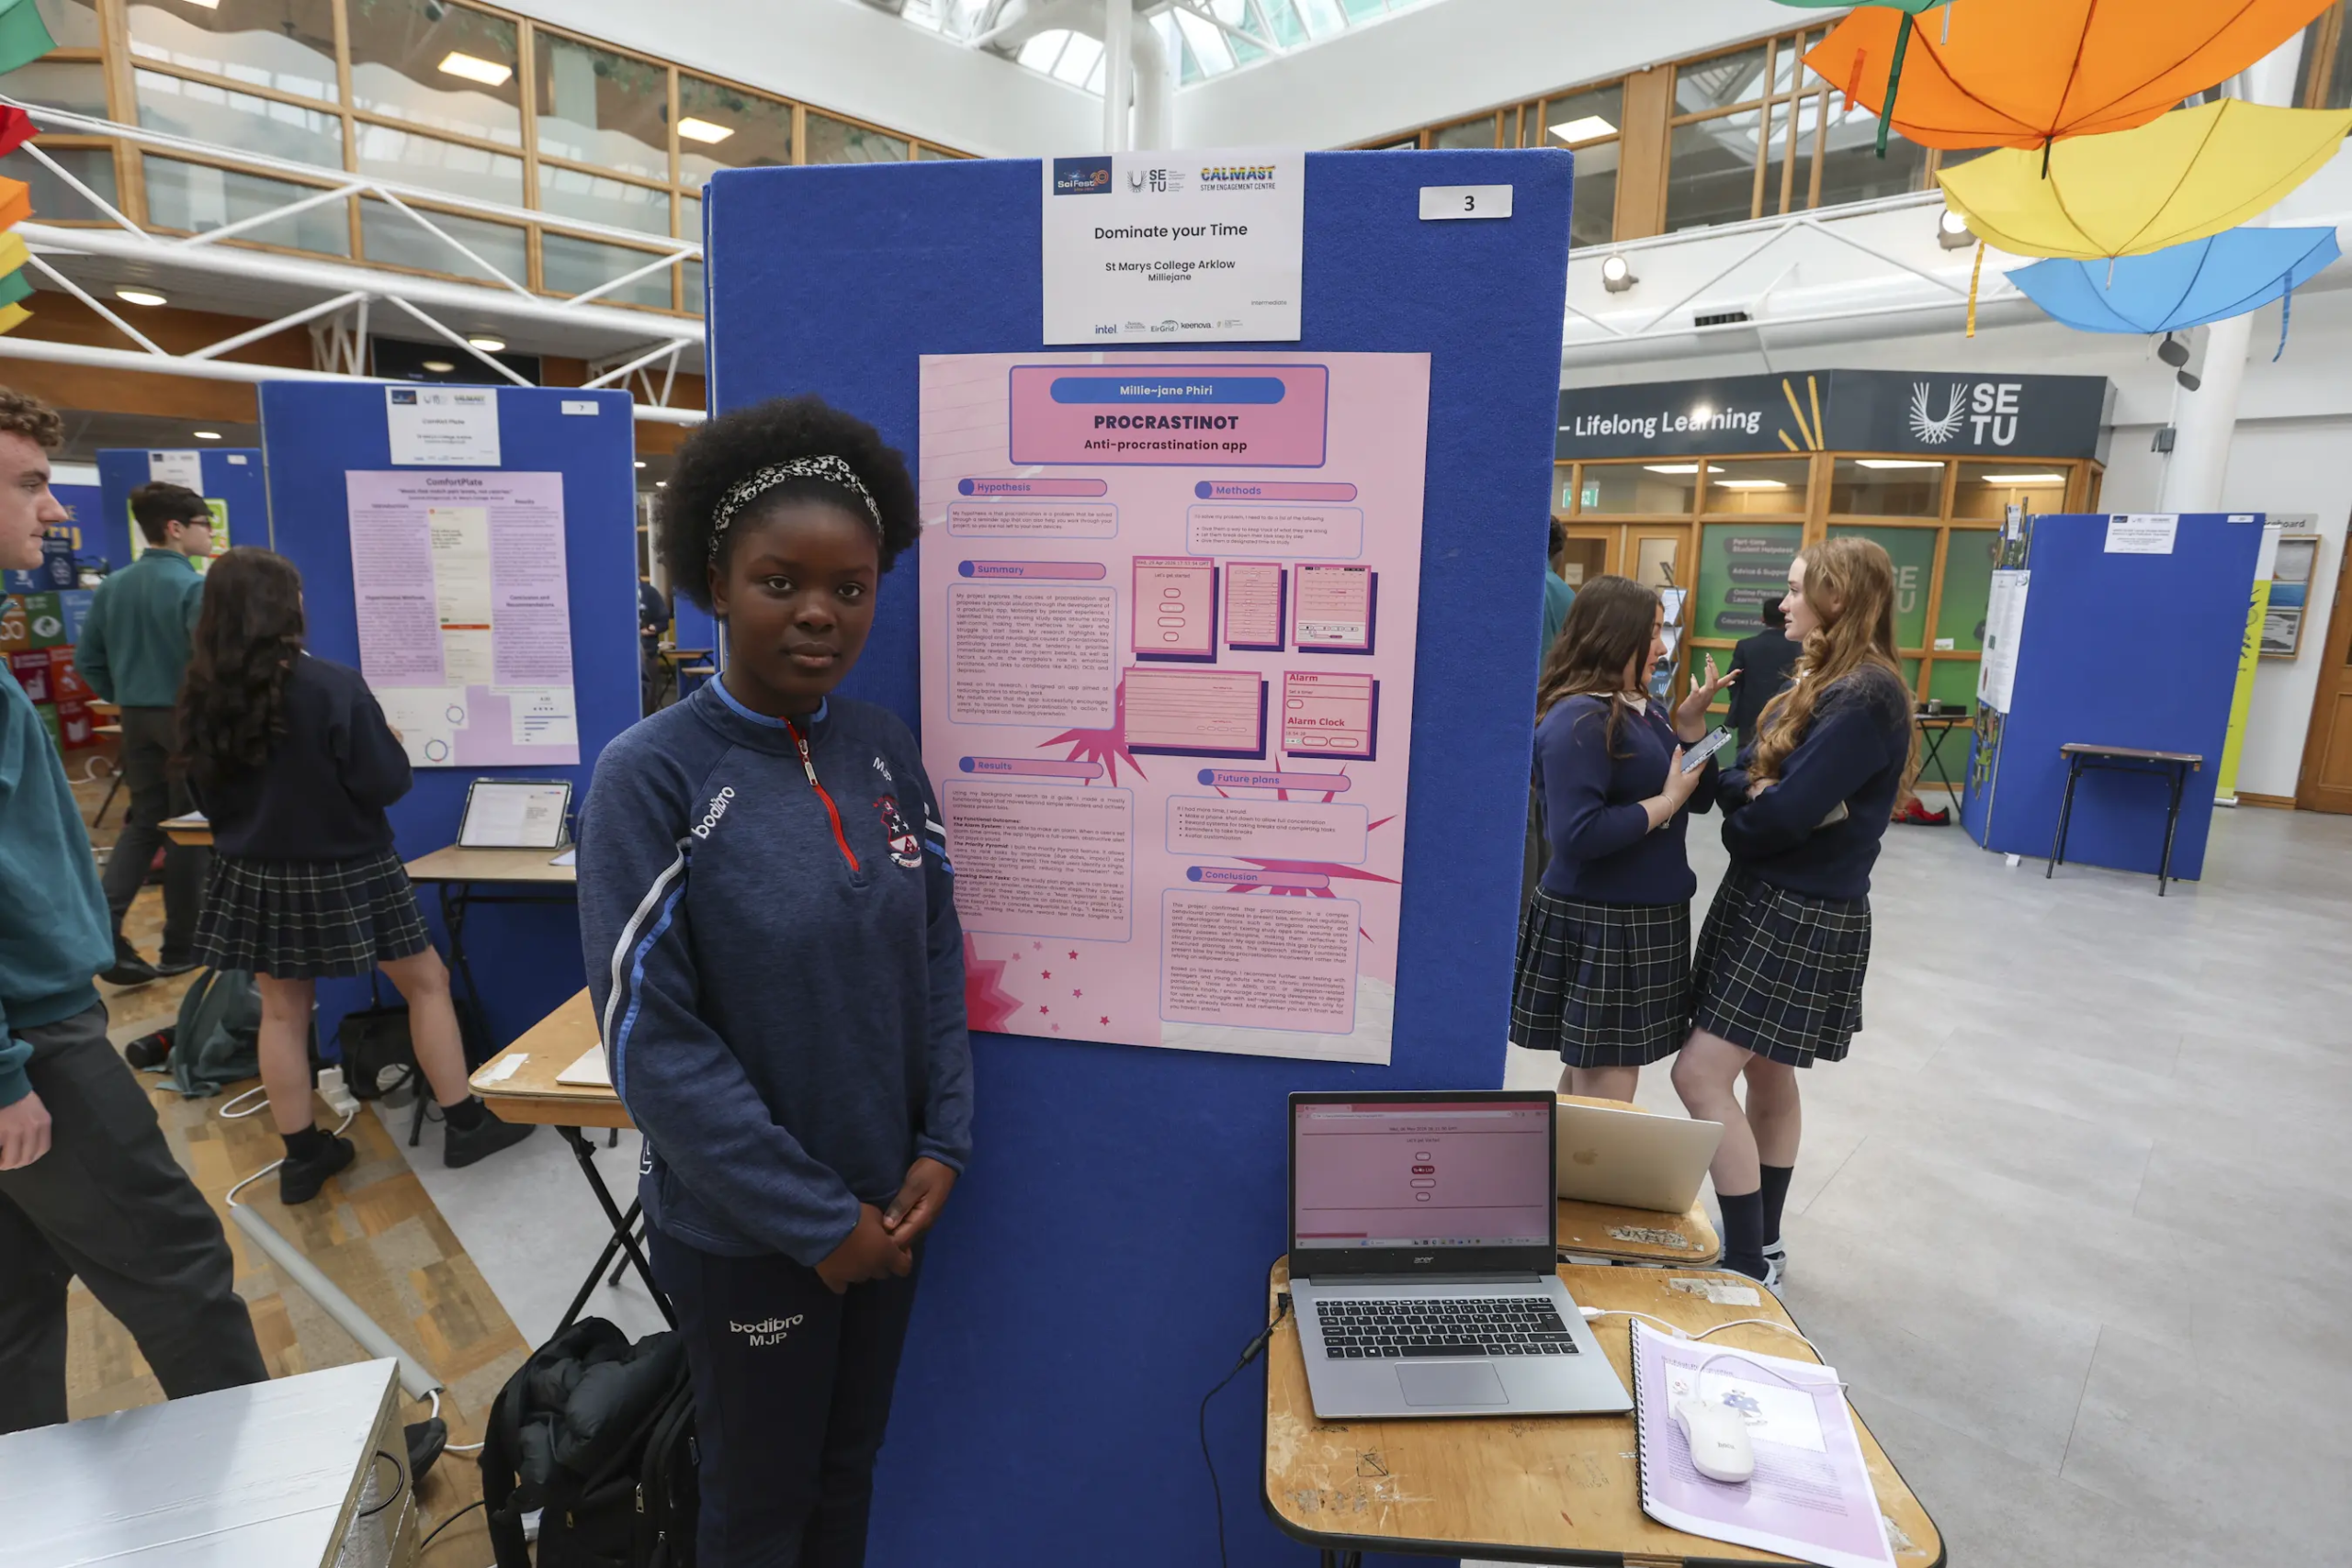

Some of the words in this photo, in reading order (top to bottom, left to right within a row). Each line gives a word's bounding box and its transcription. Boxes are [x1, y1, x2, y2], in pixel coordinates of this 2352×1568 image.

[1057, 179, 1095, 188] SciFest
[1090, 169, 1109, 186] 20
[1149, 169, 1167, 181] SE
[1200, 164, 1276, 182] CALMAST
[1150, 181, 1167, 193] TU
[1216, 183, 1253, 191] ENGAGEMENT
[1254, 182, 1276, 190] CENTRE
[1464, 196, 1476, 212] 3
[1094, 225, 1169, 240] Dominate
[1172, 226, 1206, 242] your
[1210, 222, 1249, 236] Time
[1104, 262, 1116, 272] St
[1118, 261, 1152, 274] Marys
[1154, 260, 1195, 273] College
[1197, 259, 1236, 270] Arklow
[1148, 272, 1193, 284] Milliejane
[1095, 323, 1117, 334] intel
[1186, 385, 1213, 396] Phiri
[1973, 382, 2022, 413] SE
[1094, 415, 1239, 430] PROCRASTINOT
[1575, 413, 1657, 439] Lifelong
[1662, 407, 1762, 434] Learning
[1971, 414, 2018, 446] TU
[1084, 438, 1219, 452] Anti-procrastination
[1222, 441, 1248, 454] app
[978, 482, 1031, 493] Hypothesis
[1216, 485, 1262, 495] Methods
[978, 565, 1024, 576] Summary
[1289, 673, 1318, 682] Alarm
[1287, 716, 1317, 726] Alarm
[1318, 717, 1345, 727] Clock
[978, 761, 1012, 771] Results
[1217, 773, 1250, 784] Future
[1252, 774, 1281, 785] plans
[691, 785, 736, 840] bodibro
[1205, 871, 1259, 882] Conclusion
[1413, 1256, 1434, 1264] acer
[729, 1314, 804, 1333] bodibro
[749, 1332, 787, 1347] MJP
